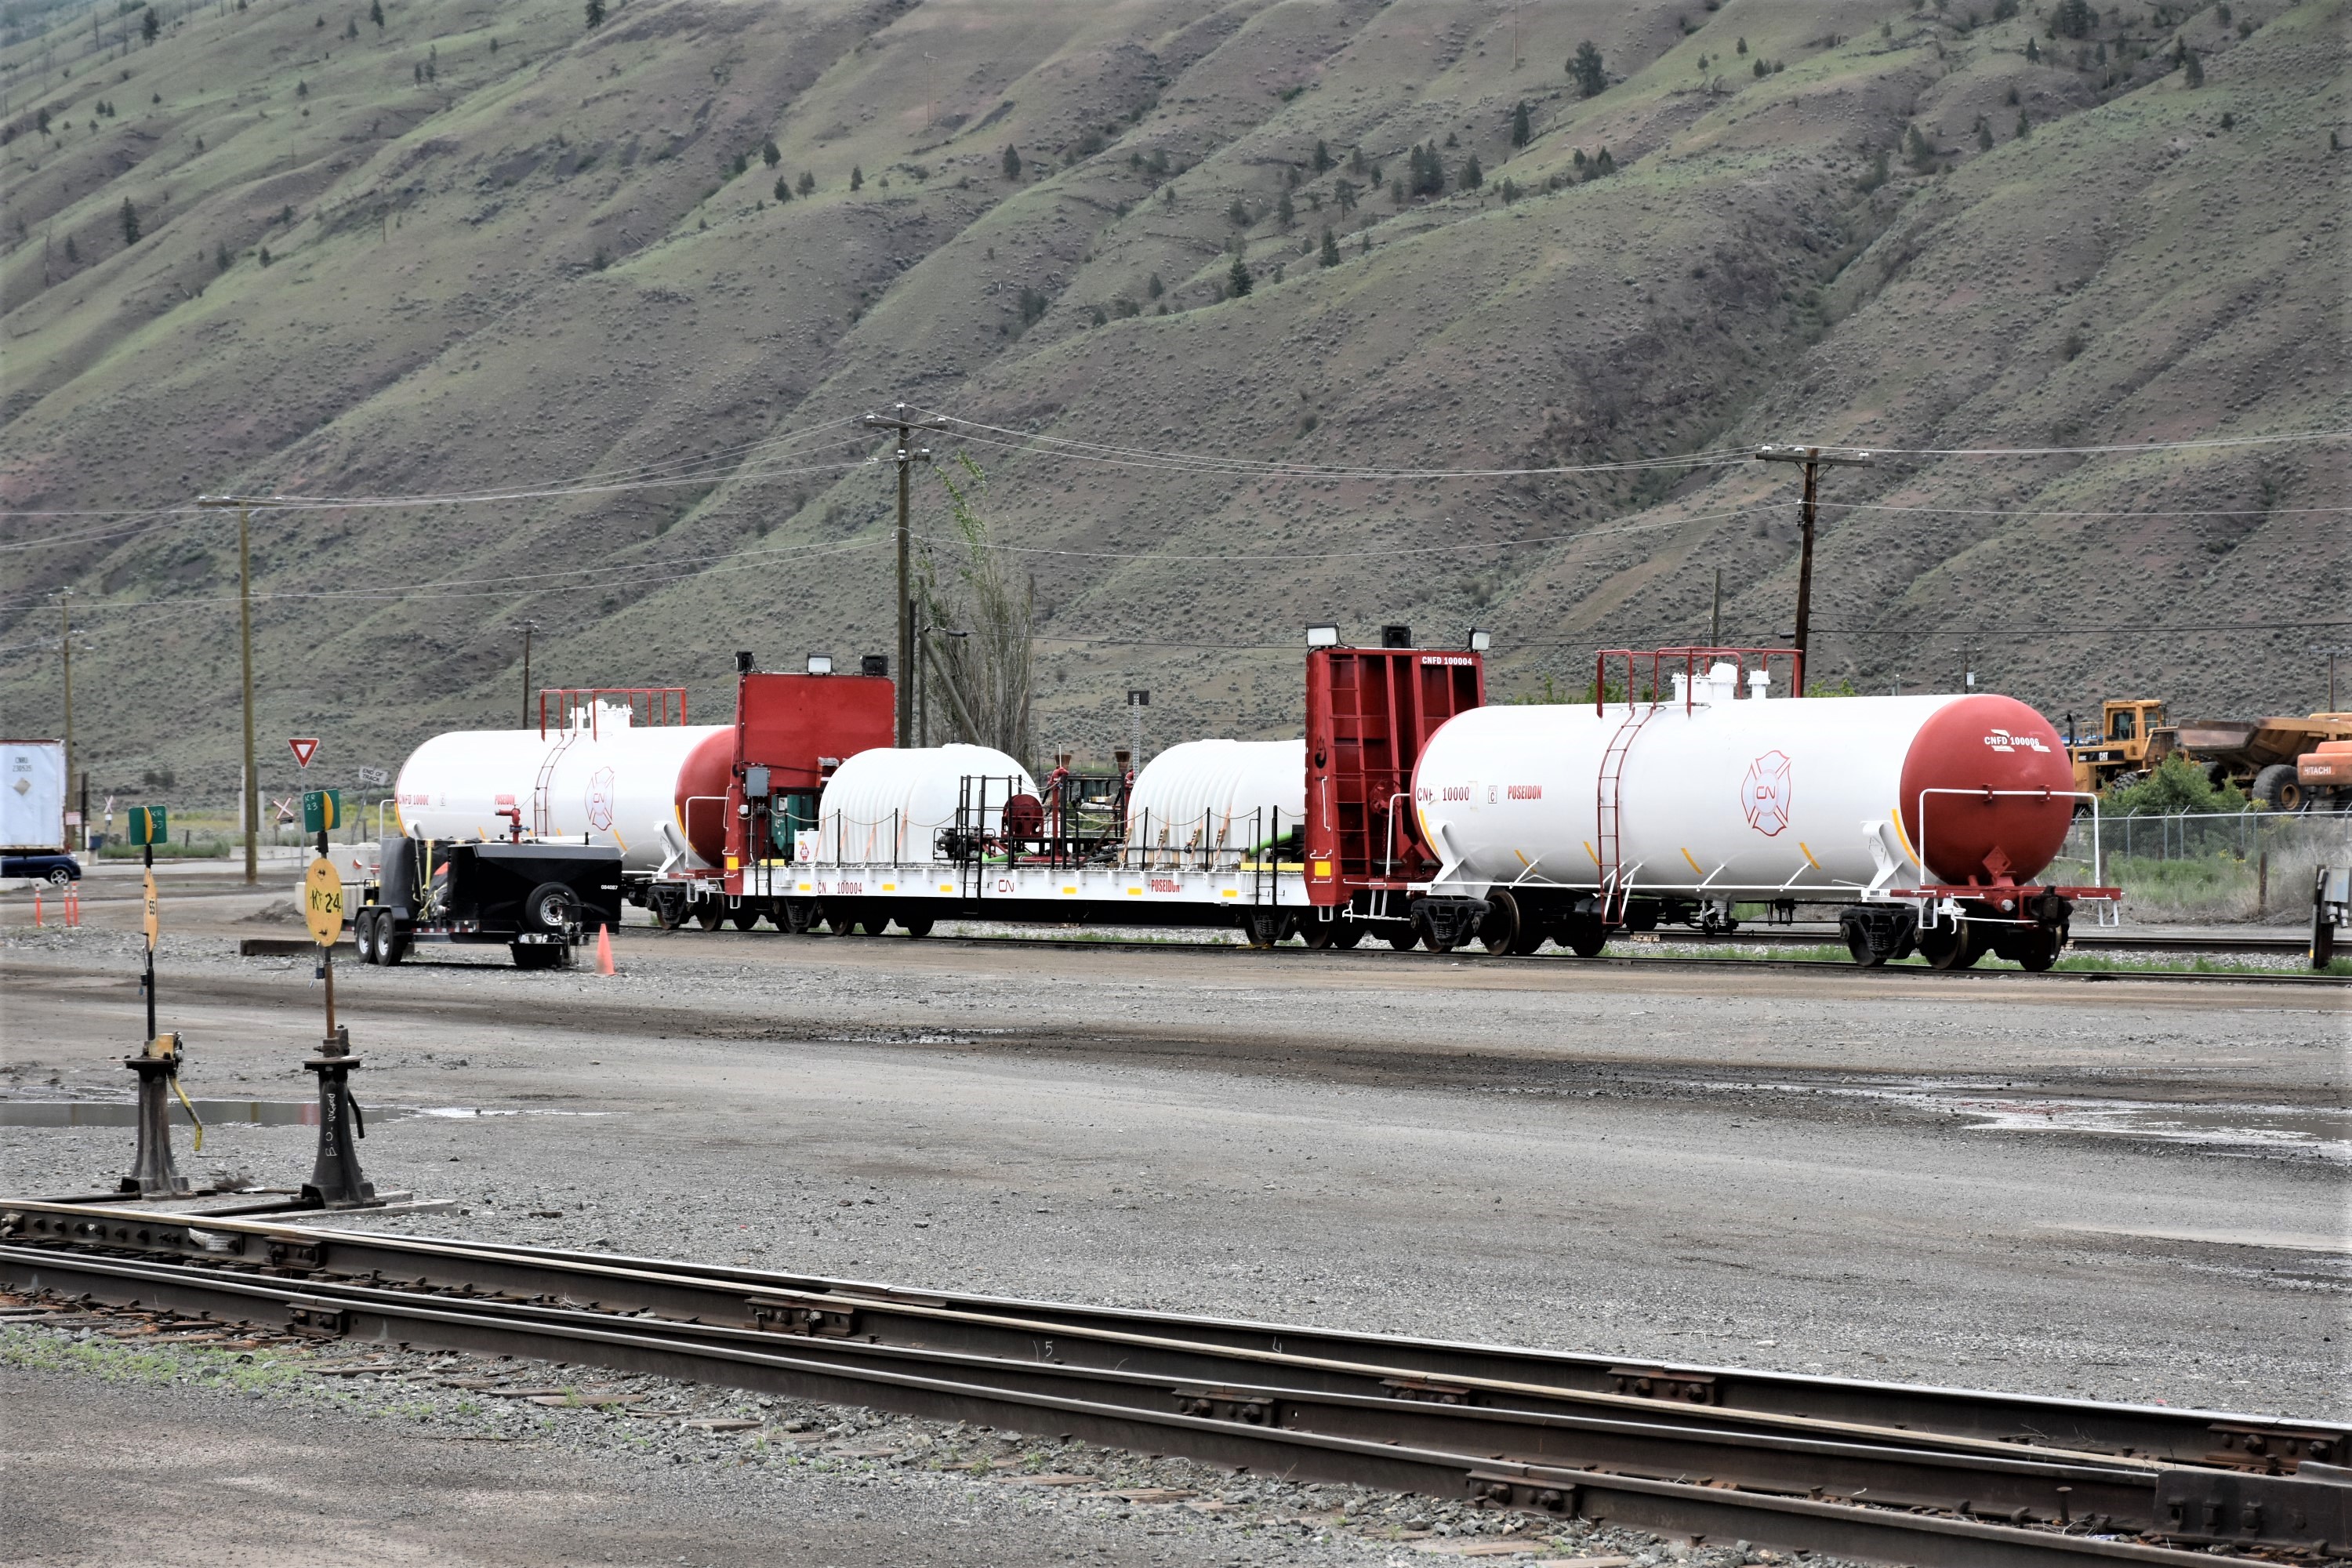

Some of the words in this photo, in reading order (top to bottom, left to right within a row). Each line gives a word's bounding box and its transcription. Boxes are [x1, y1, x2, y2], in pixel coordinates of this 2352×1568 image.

[1421, 656, 1442, 665] CNFD
[1444, 657, 1472, 666] 100004
[1984, 736, 2008, 745] CNFD
[2010, 737, 2039, 746] 100006
[2099, 752, 2108, 761] CAT
[2304, 766, 2332, 775] HITACHI
[362, 773, 379, 782] TRACK
[1490, 791, 1495, 802] C
[1508, 785, 1542, 800] POSEIDON
[1756, 786, 1776, 800] CN
[593, 793, 605, 803] CN
[307, 802, 318, 811] 23
[817, 881, 826, 895] CN
[837, 882, 862, 895] 100004
[998, 879, 1014, 893] CN
[325, 892, 341, 913] 24
[1045, 1340, 1053, 1357] 5
